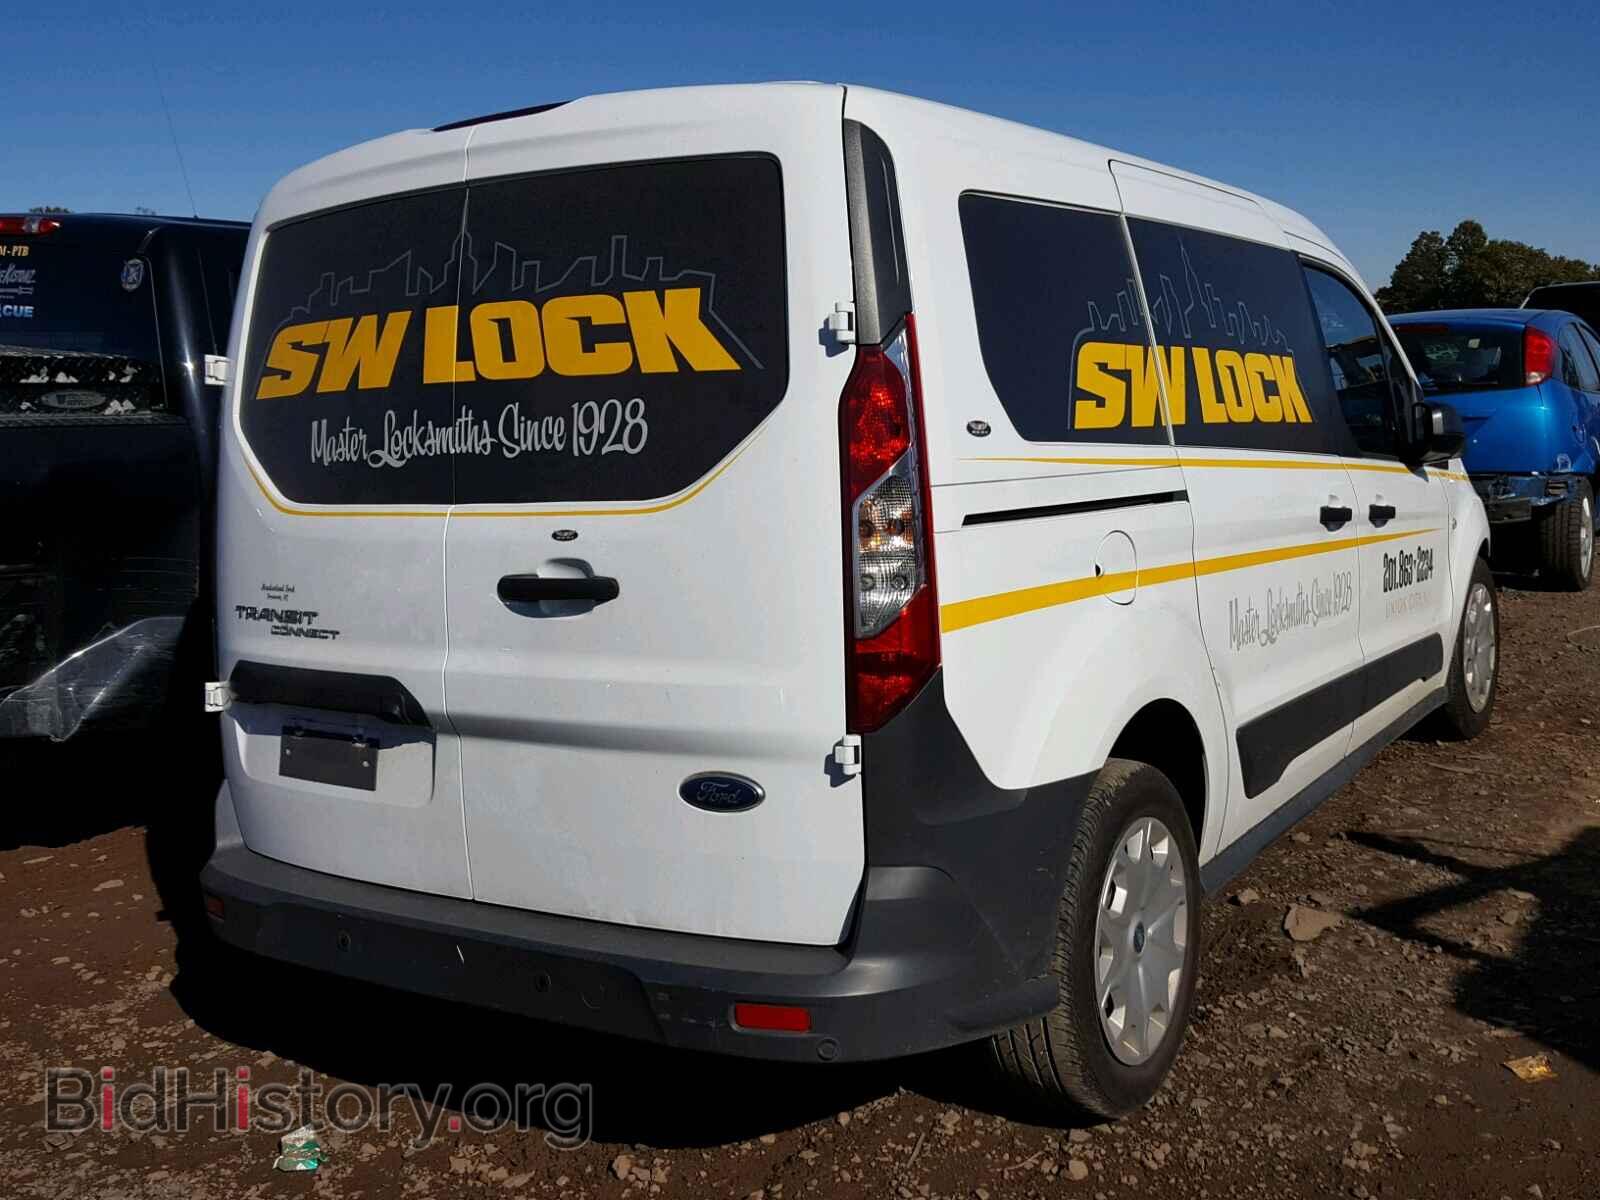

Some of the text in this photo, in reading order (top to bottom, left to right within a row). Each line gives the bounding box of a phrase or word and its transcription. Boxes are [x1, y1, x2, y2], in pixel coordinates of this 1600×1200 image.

[0, 304, 34, 318] CUE
[255, 287, 742, 401] SW LOCK
[1073, 341, 1313, 430] SW LOCK
[311, 398, 649, 469] Master Locksmiths Since 1928
[235, 604, 319, 625] TRANSIT
[270, 625, 340, 640] CONNECT
[1229, 598, 1260, 650] Master
[1333, 571, 1352, 616] 1928
[696, 780, 743, 804] Ford
